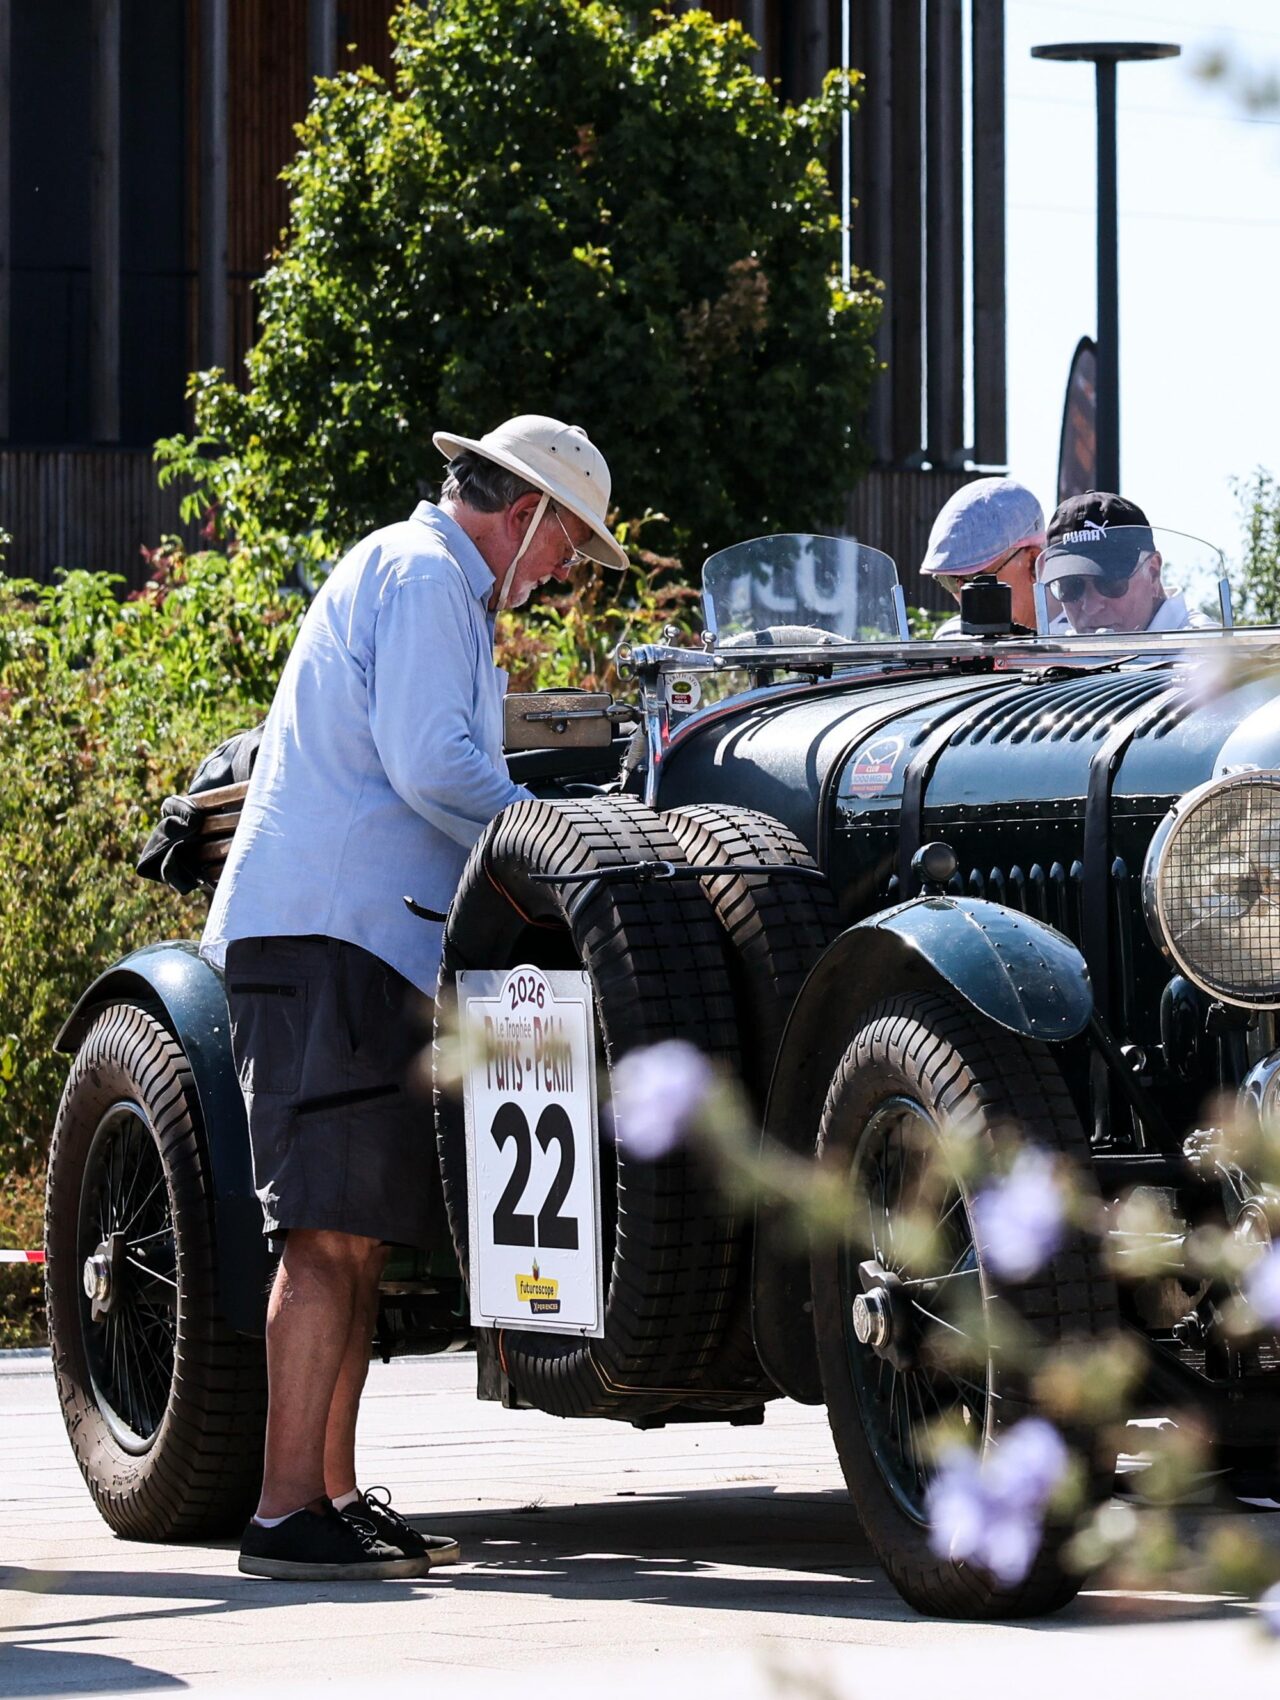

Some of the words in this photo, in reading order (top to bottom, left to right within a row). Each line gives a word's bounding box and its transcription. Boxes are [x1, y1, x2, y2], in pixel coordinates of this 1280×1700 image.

[1063, 530, 1101, 545] PUMA
[508, 975, 545, 1010] 2026
[495, 1017, 505, 1038] Le
[505, 1016, 532, 1040] Trophée
[490, 1101, 579, 1250] 22
[520, 1280, 555, 1299] futuroscope
